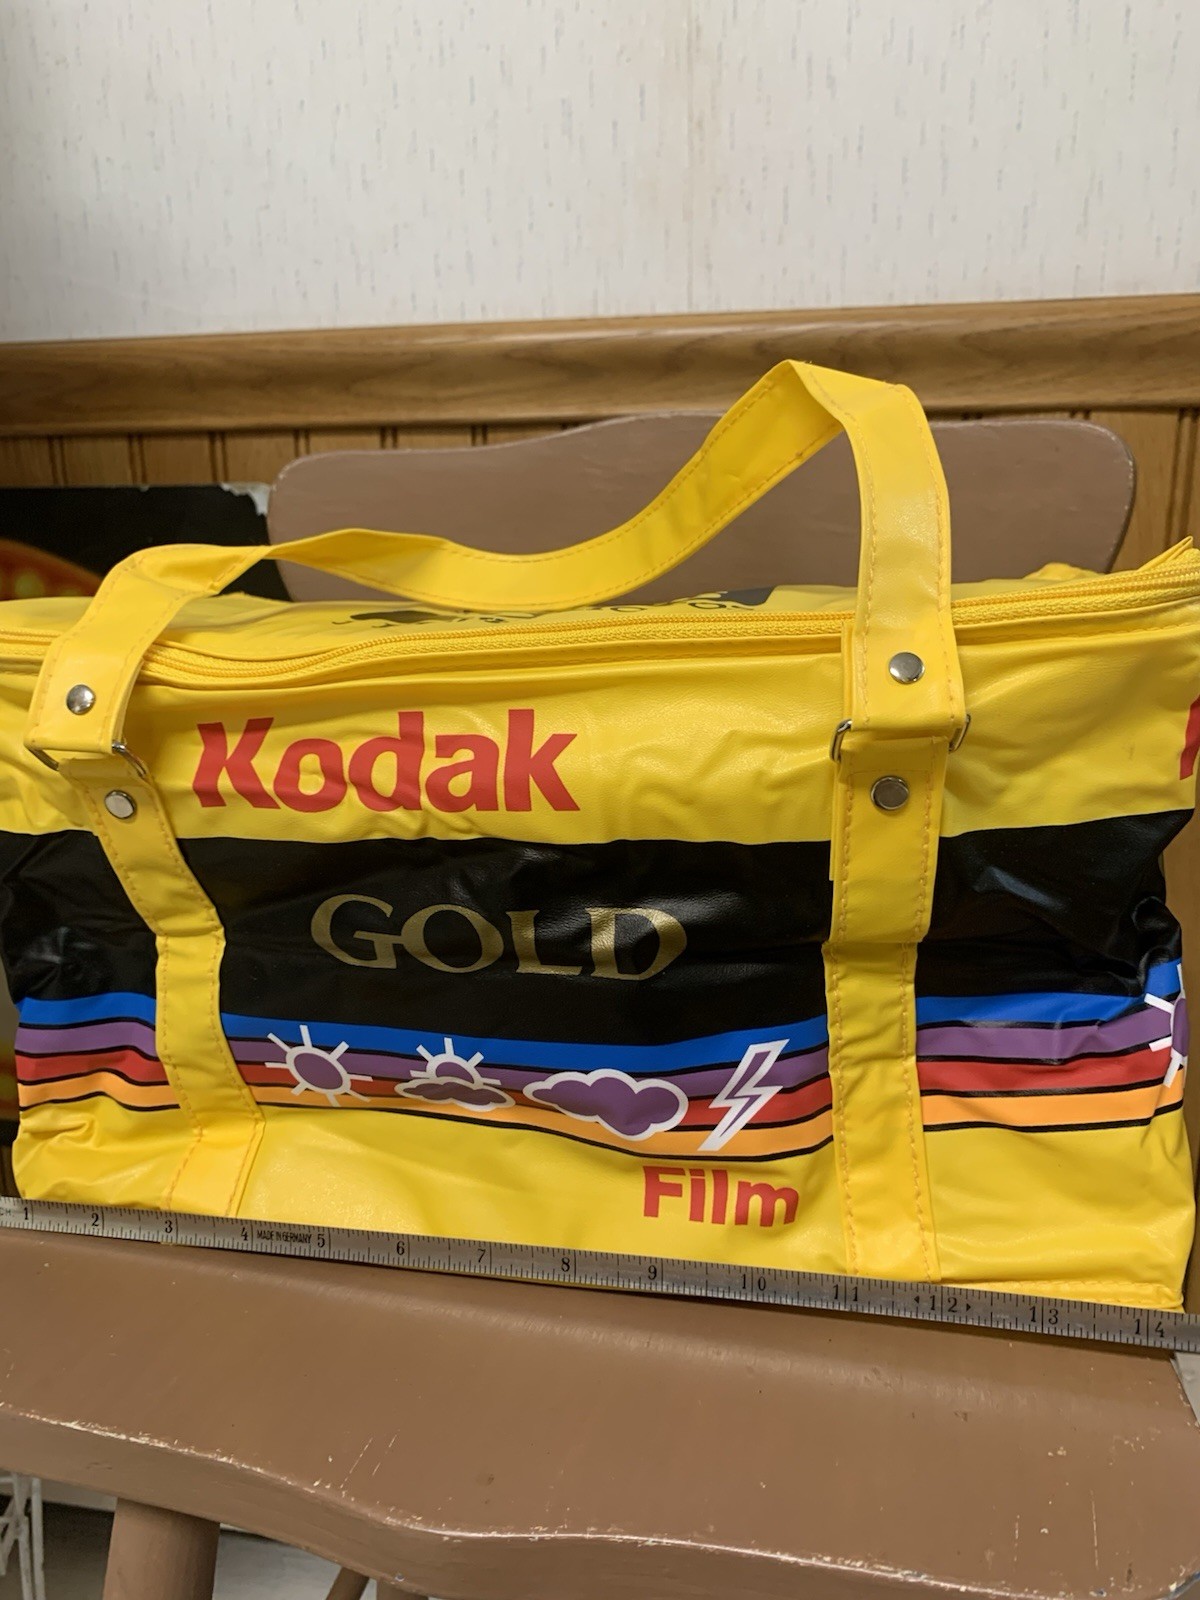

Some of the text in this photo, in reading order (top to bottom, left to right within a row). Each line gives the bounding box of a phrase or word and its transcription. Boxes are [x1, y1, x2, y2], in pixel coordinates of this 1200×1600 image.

[192, 709, 580, 813] Kodak
[311, 894, 687, 981] GOLD
[643, 1165, 799, 1227] Film
[23, 1206, 29, 1220] 1
[91, 1212, 99, 1227] 2
[165, 1219, 173, 1234] 3
[240, 1227, 248, 1241] 4
[317, 1233, 326, 1248] 5
[396, 1241, 405, 1256] 6
[477, 1248, 486, 1263] 7
[561, 1256, 570, 1272] 8
[647, 1264, 657, 1280] 9
[256, 1229, 274, 1240] MADE
[282, 1231, 312, 1244] GERMANY
